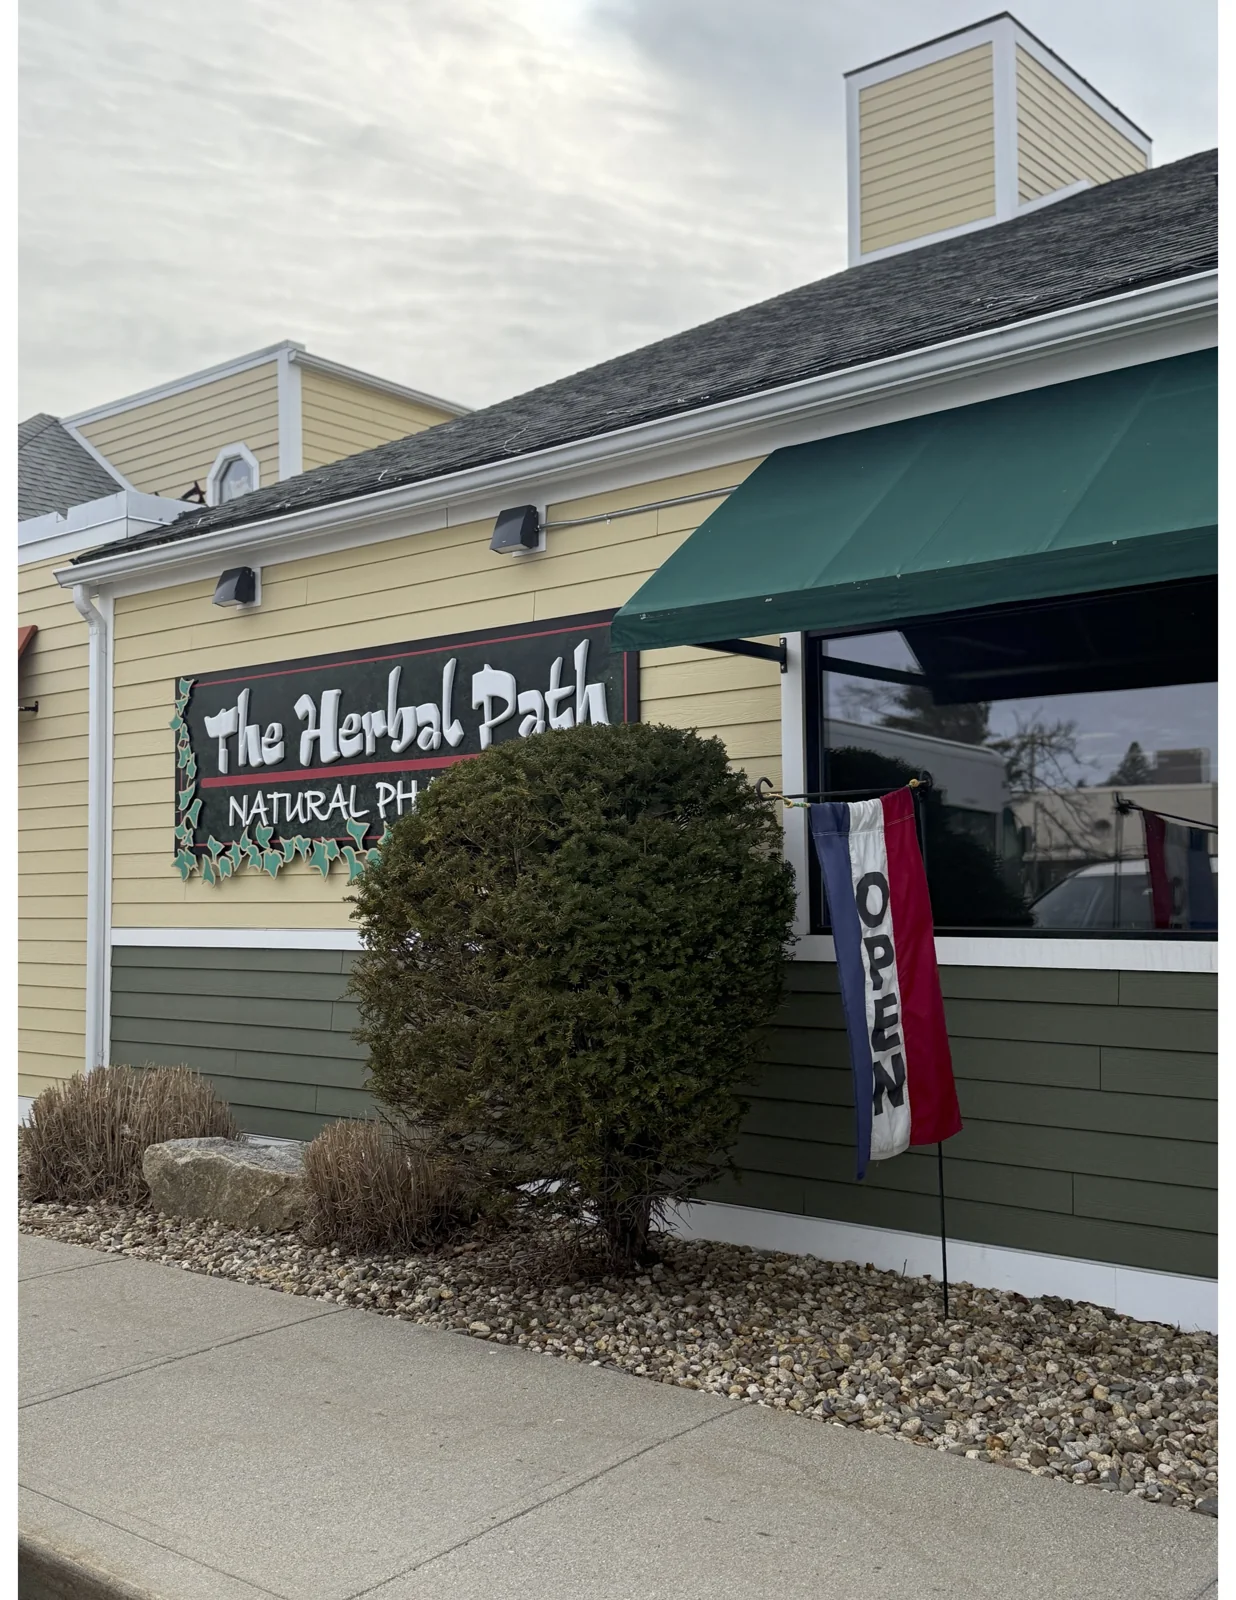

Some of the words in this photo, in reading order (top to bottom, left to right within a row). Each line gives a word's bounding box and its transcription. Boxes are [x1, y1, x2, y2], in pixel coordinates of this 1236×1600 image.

[204, 688, 285, 774] The
[293, 657, 464, 767] Herbal
[471, 638, 611, 751] Path
[228, 783, 371, 828] NATURAL
[375, 776, 436, 819] PH
[855, 871, 907, 1116] OPEN
